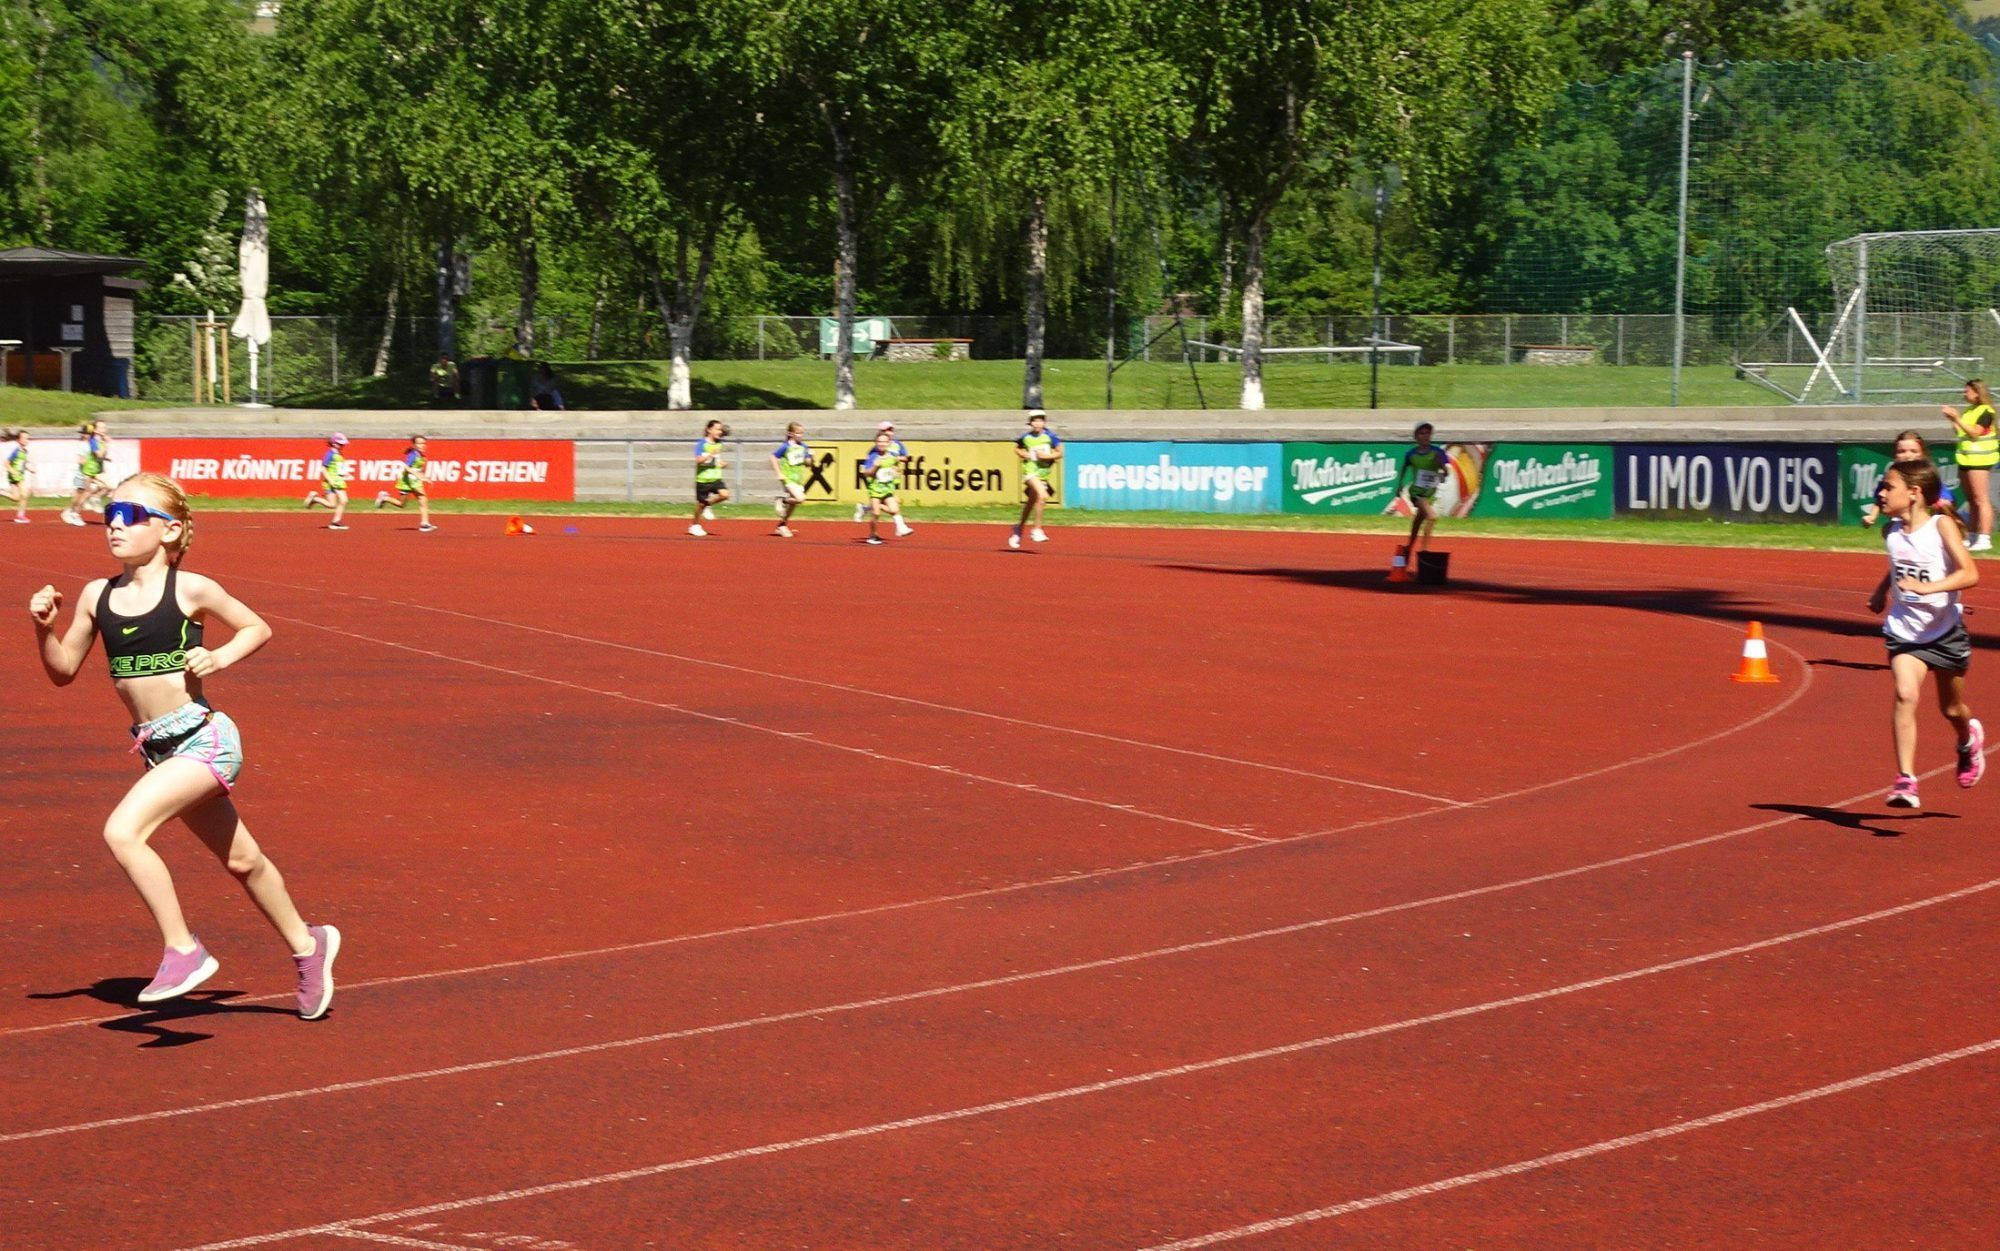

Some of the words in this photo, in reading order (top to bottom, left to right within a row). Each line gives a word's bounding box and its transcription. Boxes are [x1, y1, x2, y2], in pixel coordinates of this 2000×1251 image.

[170, 458, 220, 480] HIER
[221, 454, 305, 480] KÖNNTE
[307, 459, 356, 480] IHE
[463, 460, 548, 482] STEHEN!
[855, 456, 1003, 491] Rffeisen
[1077, 454, 1268, 501] meusburger
[1629, 455, 1713, 510] LIMO
[135, 650, 187, 671] PRO
